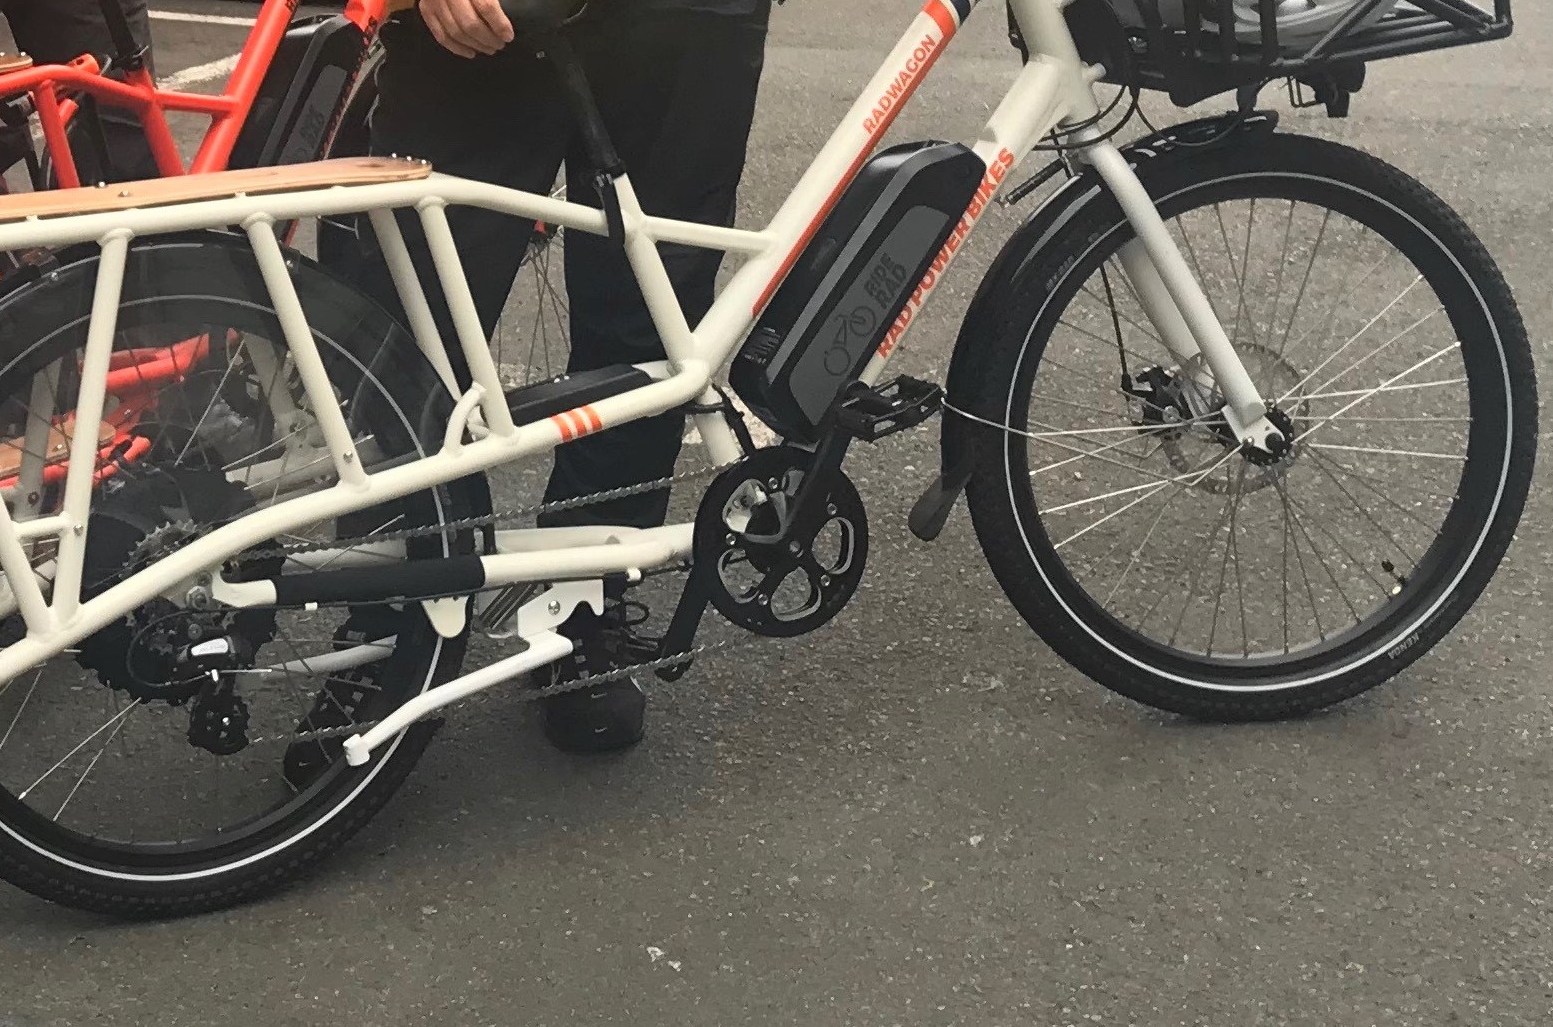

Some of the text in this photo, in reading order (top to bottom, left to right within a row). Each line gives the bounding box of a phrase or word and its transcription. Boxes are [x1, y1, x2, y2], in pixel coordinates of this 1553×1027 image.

[862, 34, 937, 135] RADWAGON
[863, 252, 891, 296] RIDE
[873, 263, 907, 310] RAD
[877, 147, 1016, 360] RAD POWER BIKES
